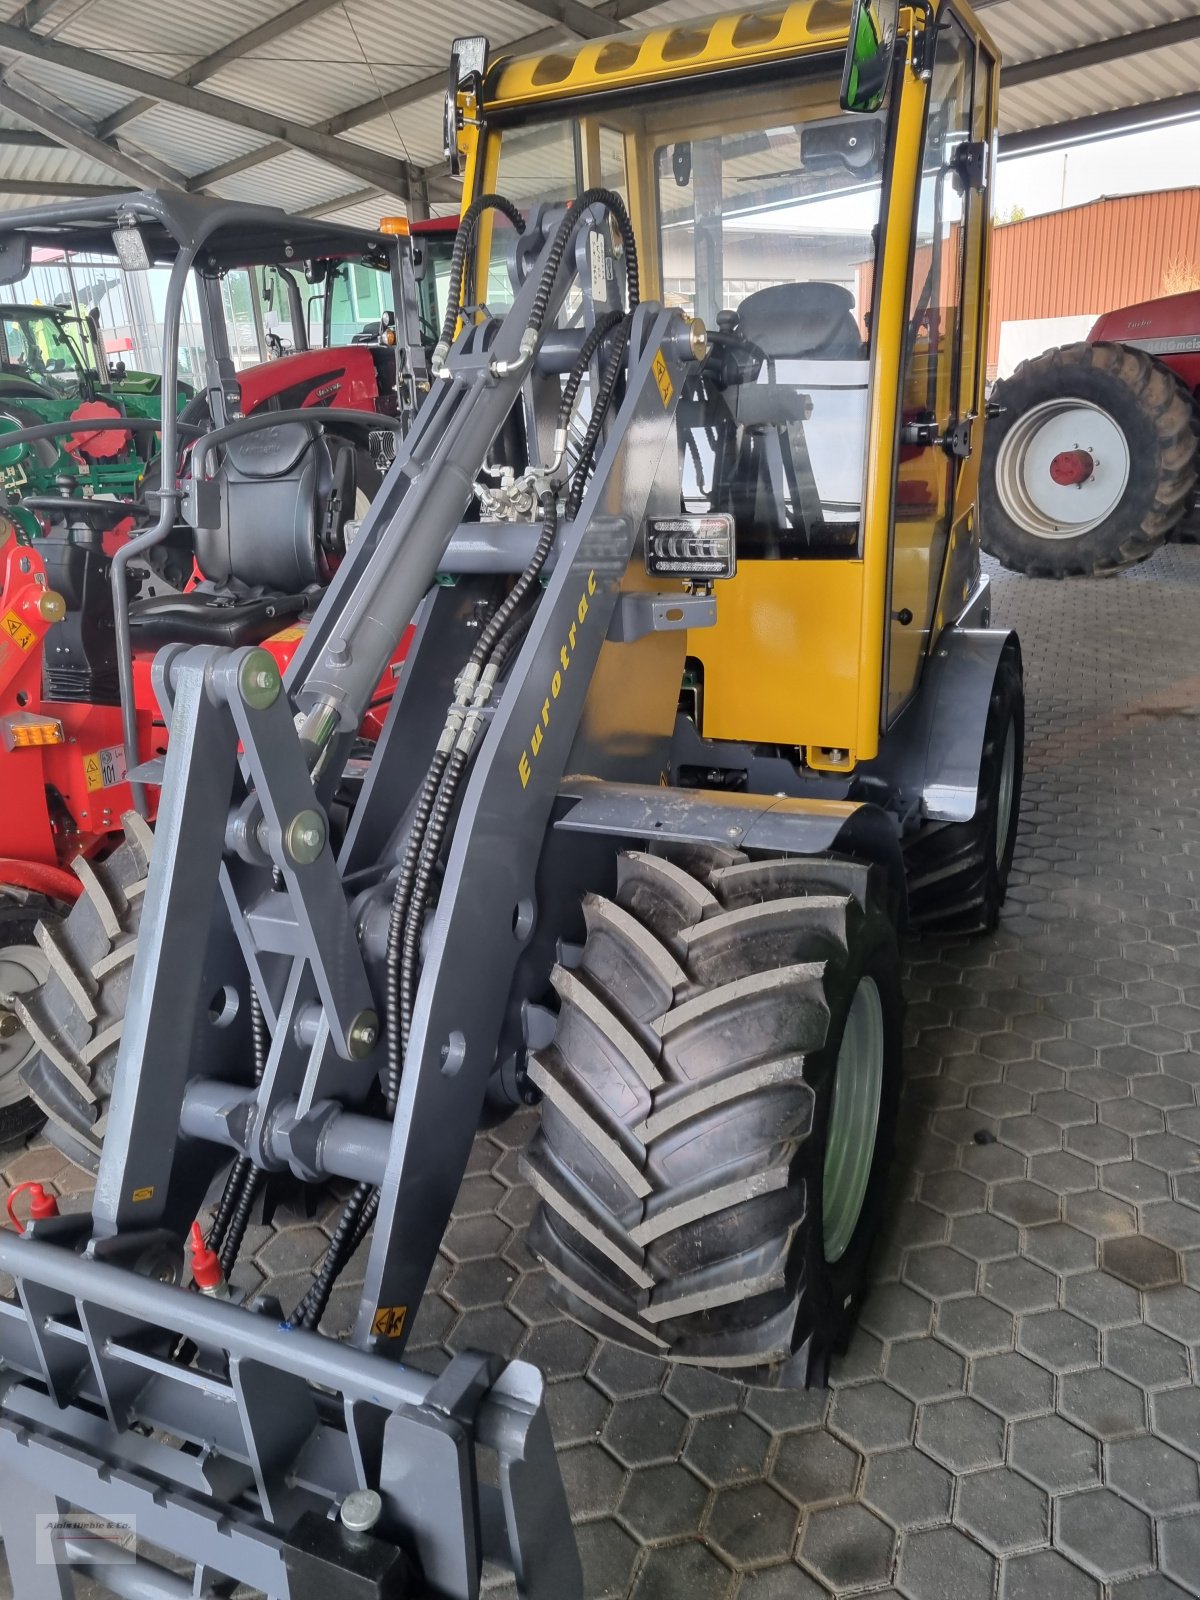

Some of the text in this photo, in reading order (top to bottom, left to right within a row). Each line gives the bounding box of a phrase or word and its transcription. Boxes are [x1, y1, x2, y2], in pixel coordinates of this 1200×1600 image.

[1127, 319, 1152, 329] Turbo
[518, 569, 597, 790] Eurotrac
[102, 763, 116, 784] 101
